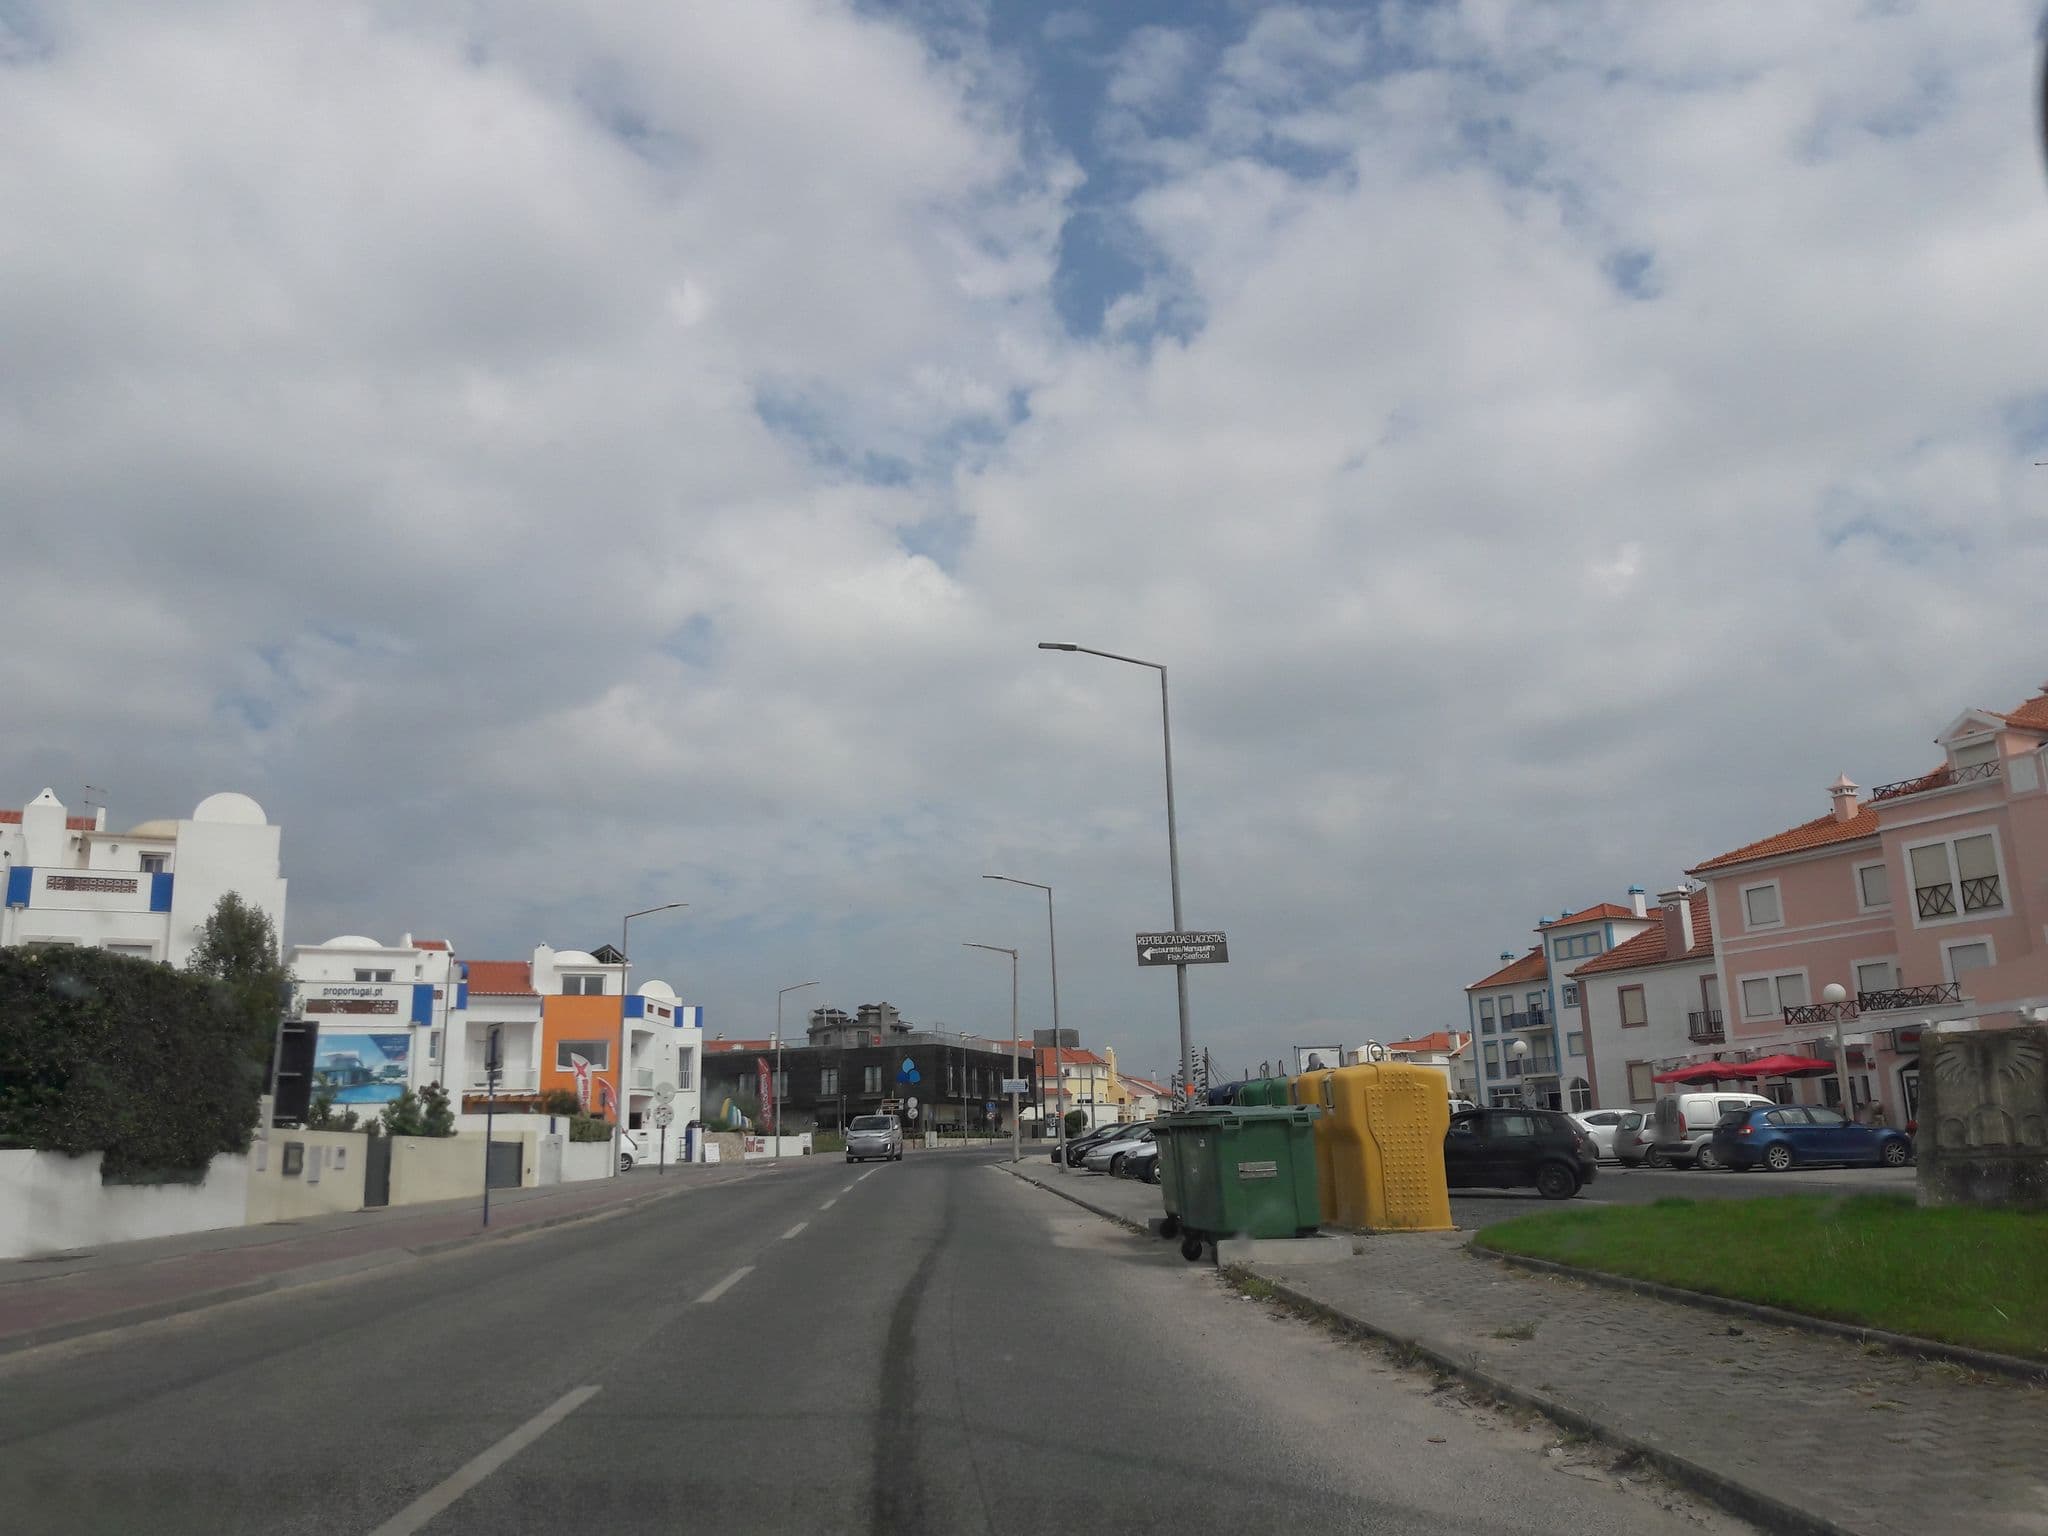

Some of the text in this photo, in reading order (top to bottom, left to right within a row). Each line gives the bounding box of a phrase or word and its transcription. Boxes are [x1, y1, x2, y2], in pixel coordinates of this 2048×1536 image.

[1176, 935, 1191, 944] DAS
[1191, 934, 1225, 943] LAGOSTAS
[322, 986, 384, 998] proportugal.pt
